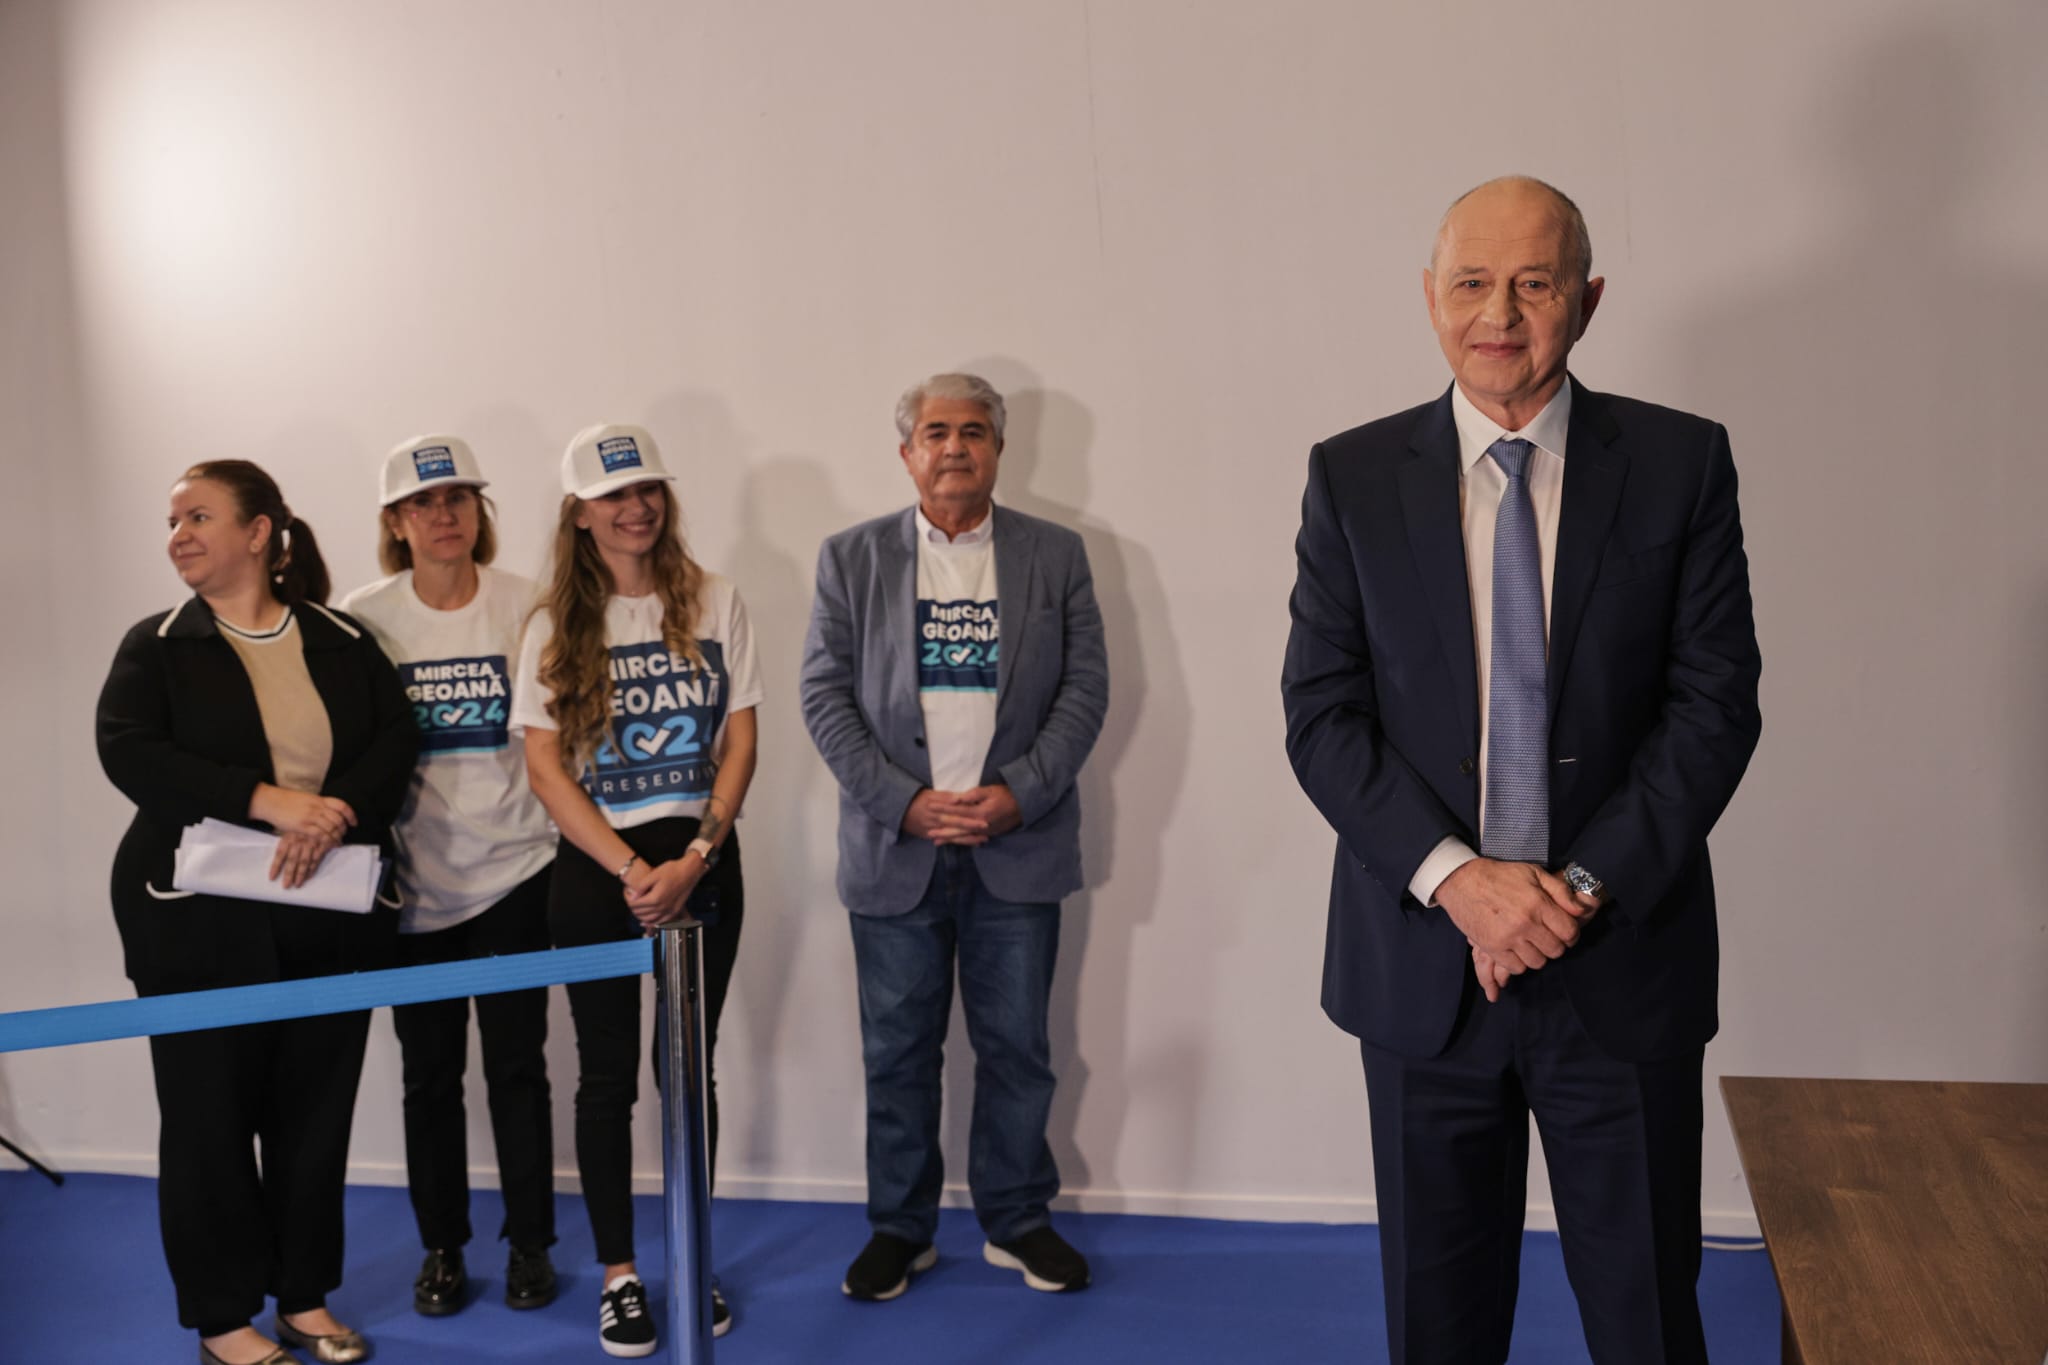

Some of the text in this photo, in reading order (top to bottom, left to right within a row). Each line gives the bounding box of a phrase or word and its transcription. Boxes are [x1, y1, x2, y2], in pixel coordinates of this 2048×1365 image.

[930, 604, 995, 622] MIRCEA
[413, 661, 495, 682] MIRCEA
[413, 699, 506, 729] 2024
